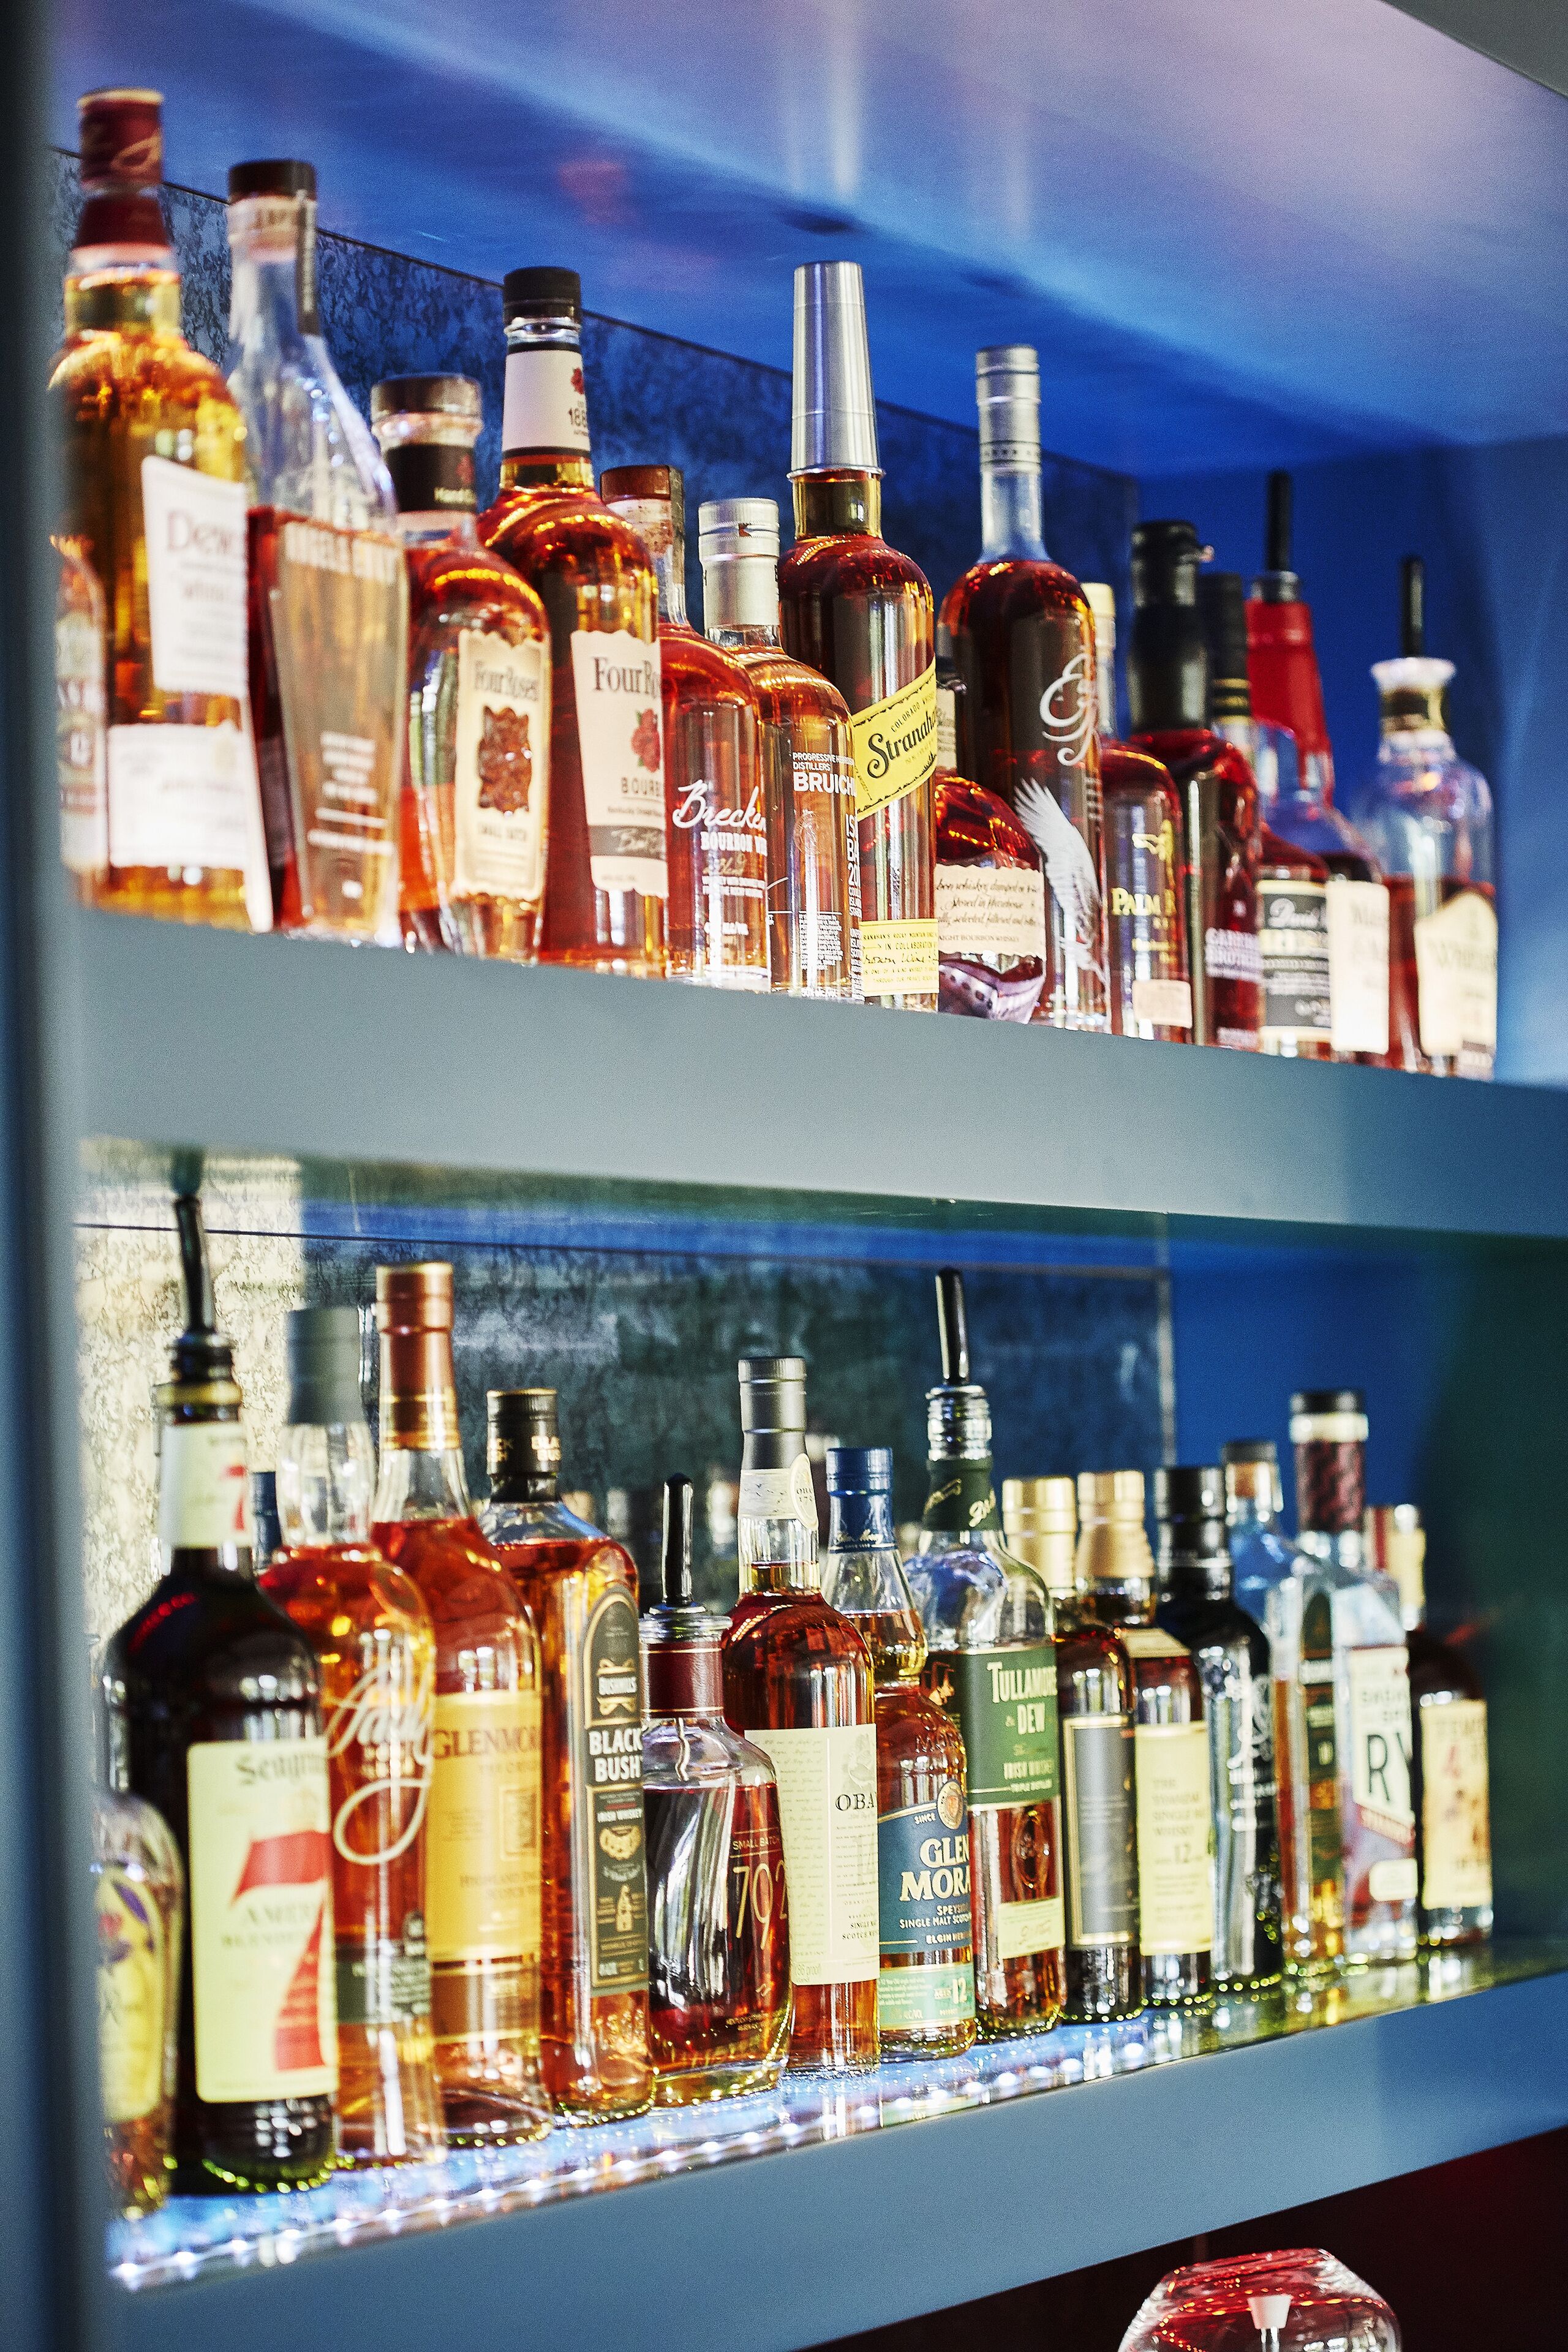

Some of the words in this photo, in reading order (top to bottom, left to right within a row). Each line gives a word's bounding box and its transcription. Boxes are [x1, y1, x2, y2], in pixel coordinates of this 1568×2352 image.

[591, 656, 641, 694] Four
[890, 701, 921, 733] COLORADO
[793, 752, 836, 763] PROGRESSIVE
[793, 761, 831, 771] DISTILLERS
[700, 831, 753, 853] BOURBON
[589, 1727, 643, 1756] BLACK
[594, 1754, 642, 1782] BUSH
[835, 1792, 876, 1812] OBA
[914, 1812, 936, 1825] SINCE
[733, 1839, 759, 1850] SMALL
[920, 1834, 970, 1869] GLEN
[899, 1916, 931, 1930] SINGLE
[932, 1915, 951, 1927] MALT
[842, 1931, 868, 1940] SCOTCH
[926, 1933, 952, 1945] ELGIN
[952, 1977, 968, 2005] 12
